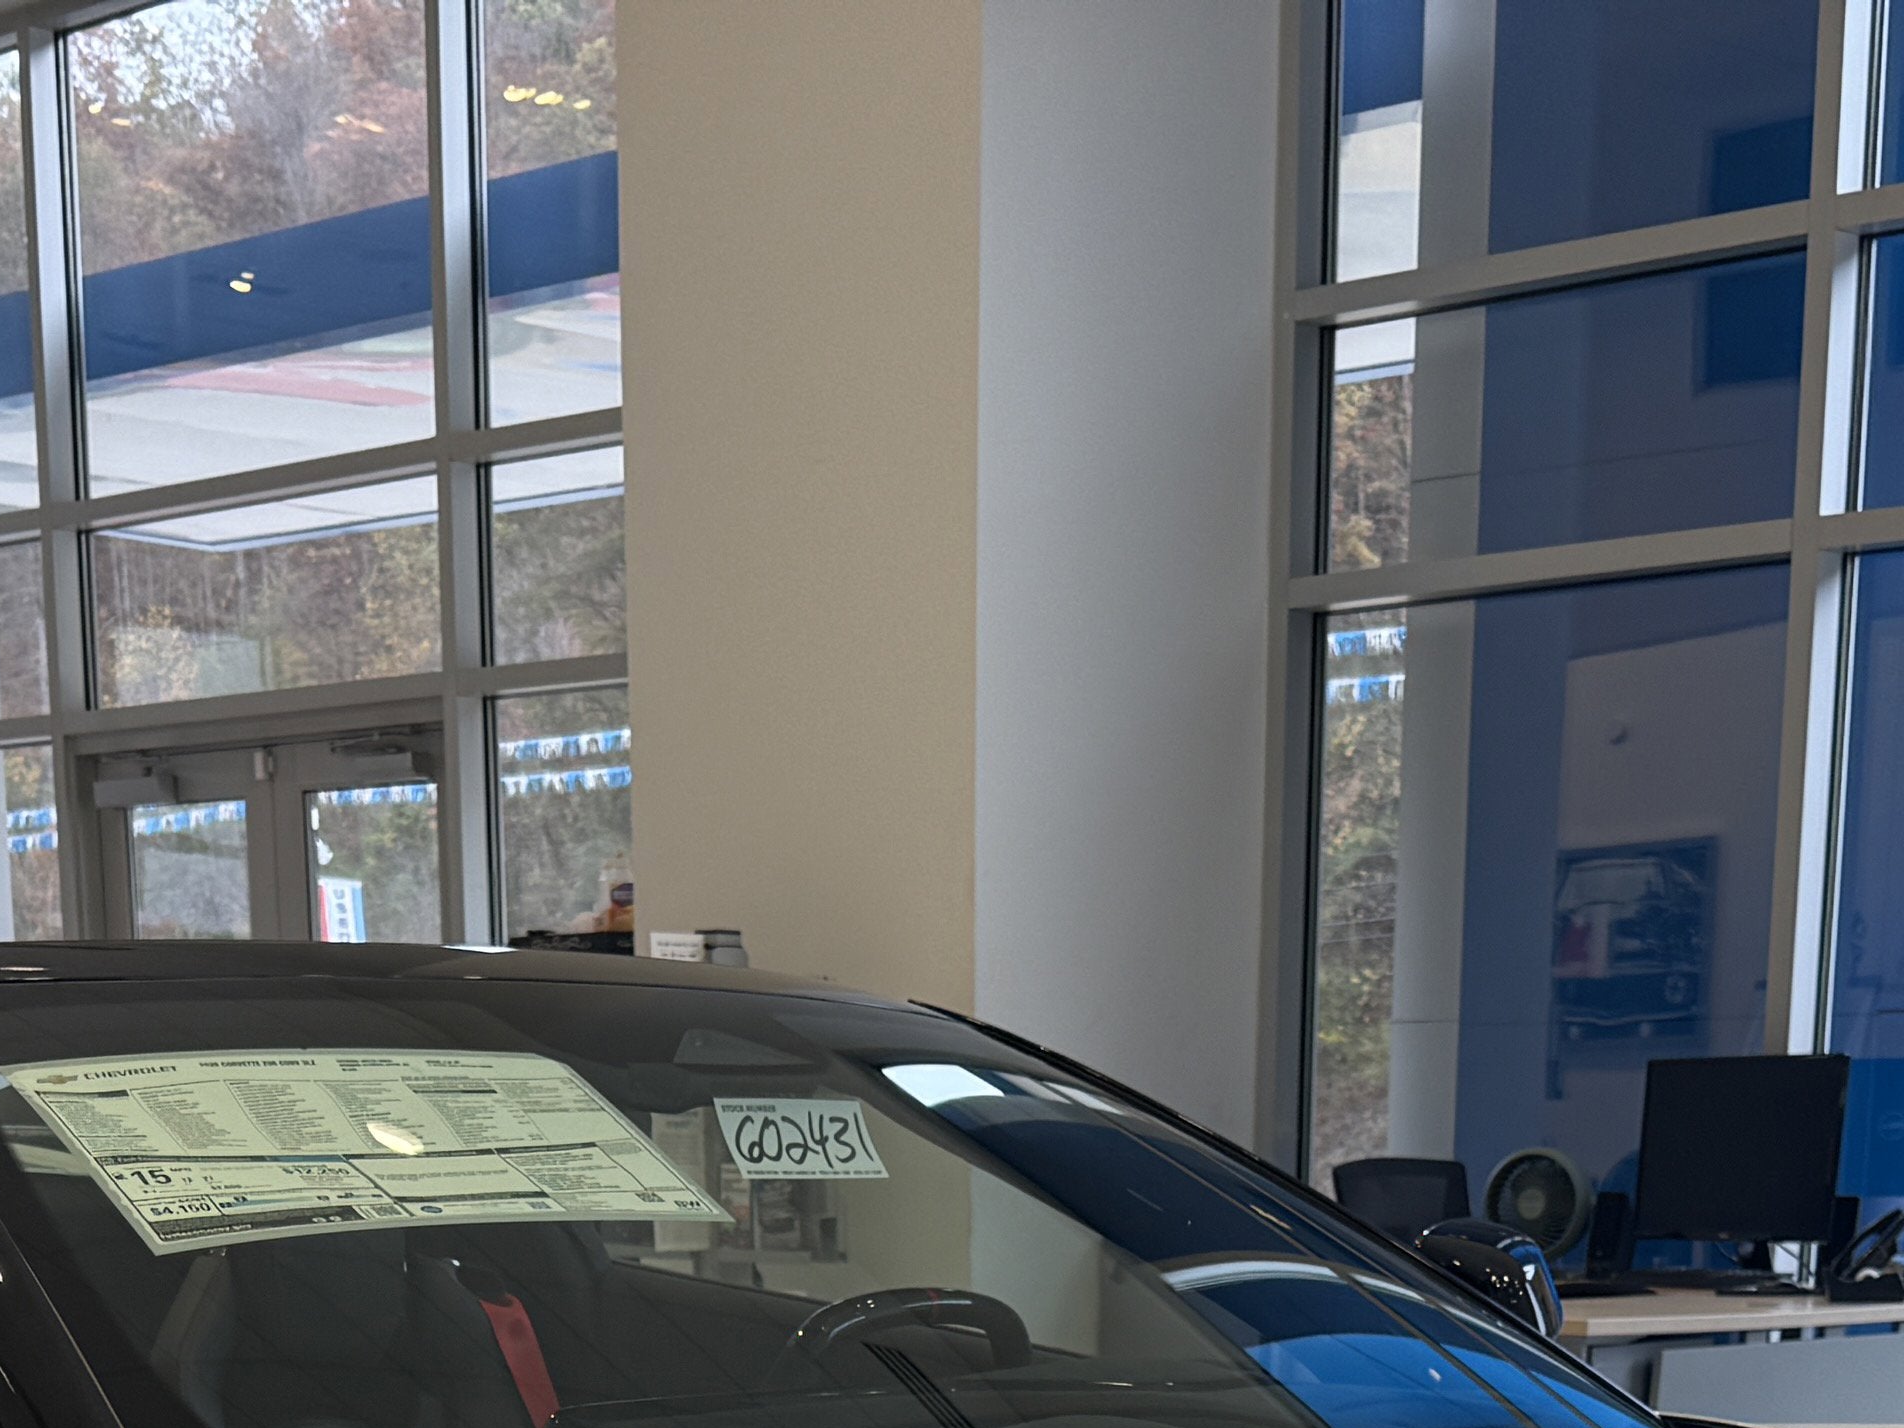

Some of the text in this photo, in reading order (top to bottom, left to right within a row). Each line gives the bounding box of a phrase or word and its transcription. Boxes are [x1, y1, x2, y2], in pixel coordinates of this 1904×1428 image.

[83, 1065, 178, 1080] CHEVROLET
[721, 1104, 776, 1113] STOCK NUMBER
[735, 1111, 874, 1169] 602431
[131, 1168, 172, 1186] 15
